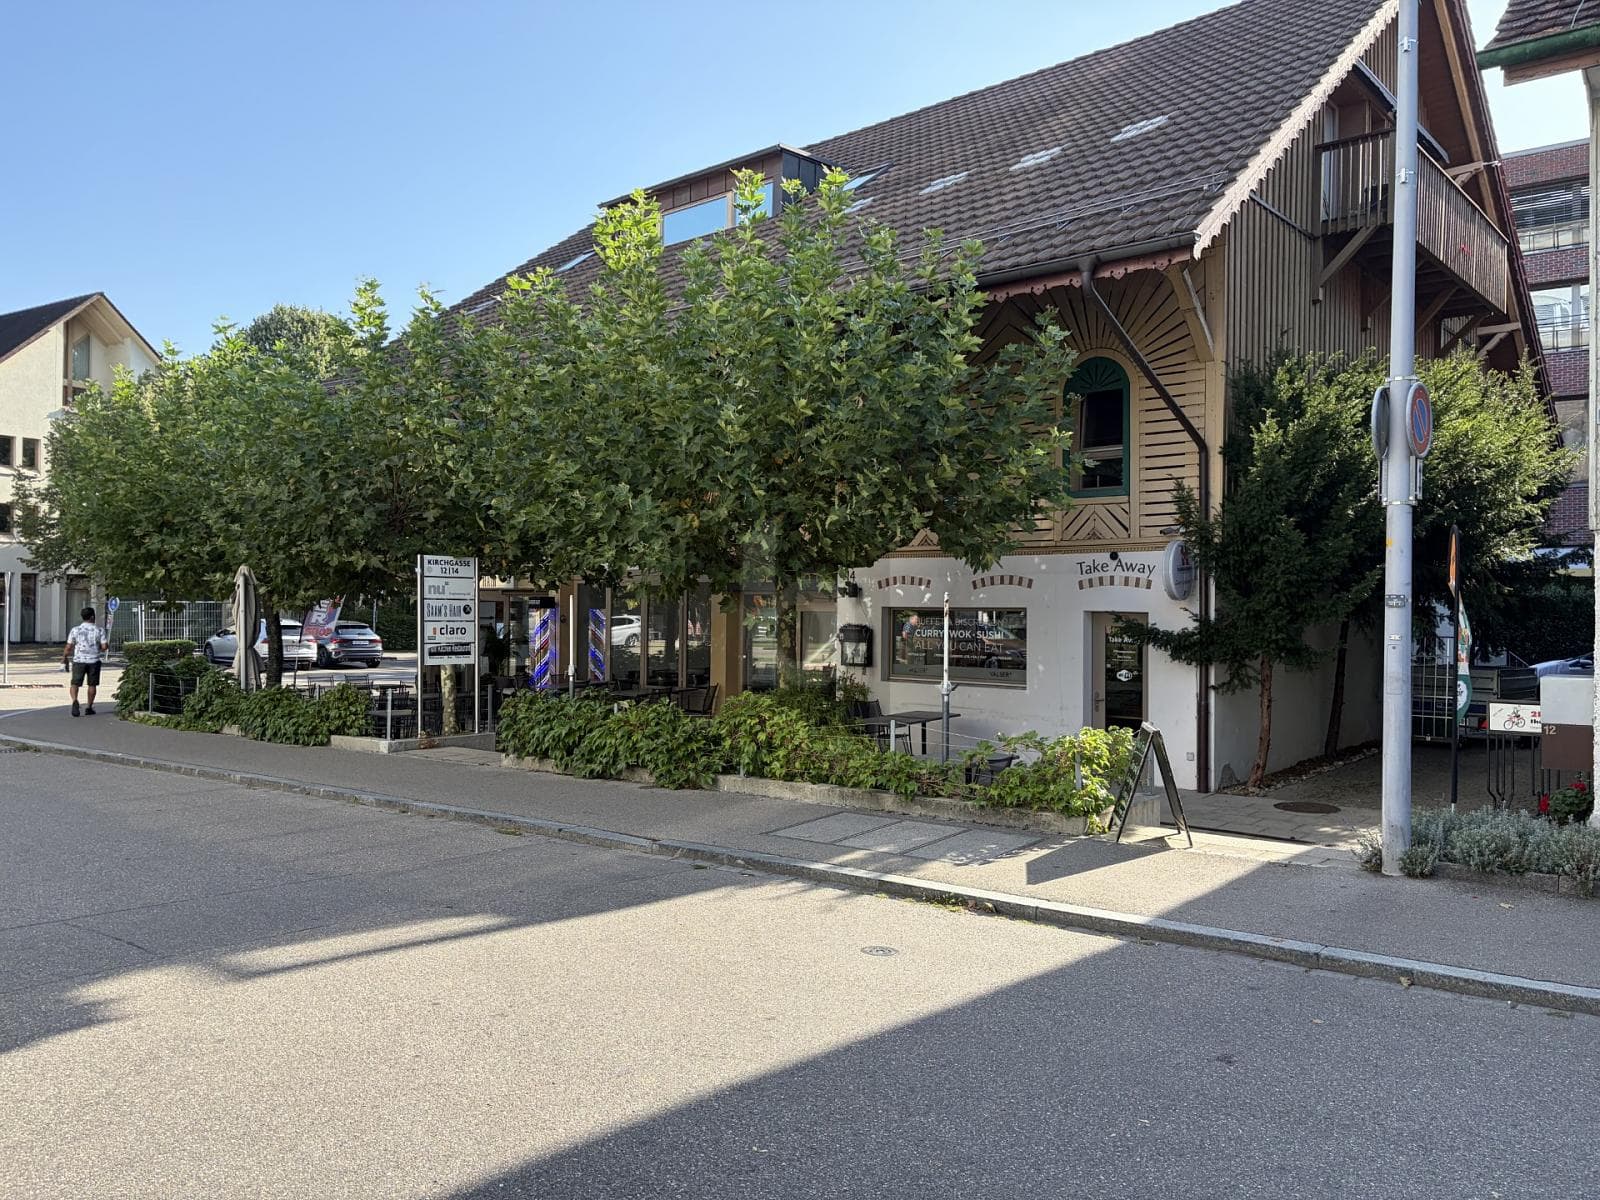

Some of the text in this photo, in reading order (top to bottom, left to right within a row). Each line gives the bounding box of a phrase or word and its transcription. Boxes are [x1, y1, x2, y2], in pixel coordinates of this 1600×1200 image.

[427, 559, 471, 567] KIRCHGASSE
[1076, 558, 1156, 578] Take Away
[439, 624, 467, 635] claro
[915, 629, 944, 638] CURRY
[914, 641, 1004, 653] ALL YU CAN EAT
[1543, 725, 1557, 735] 12
